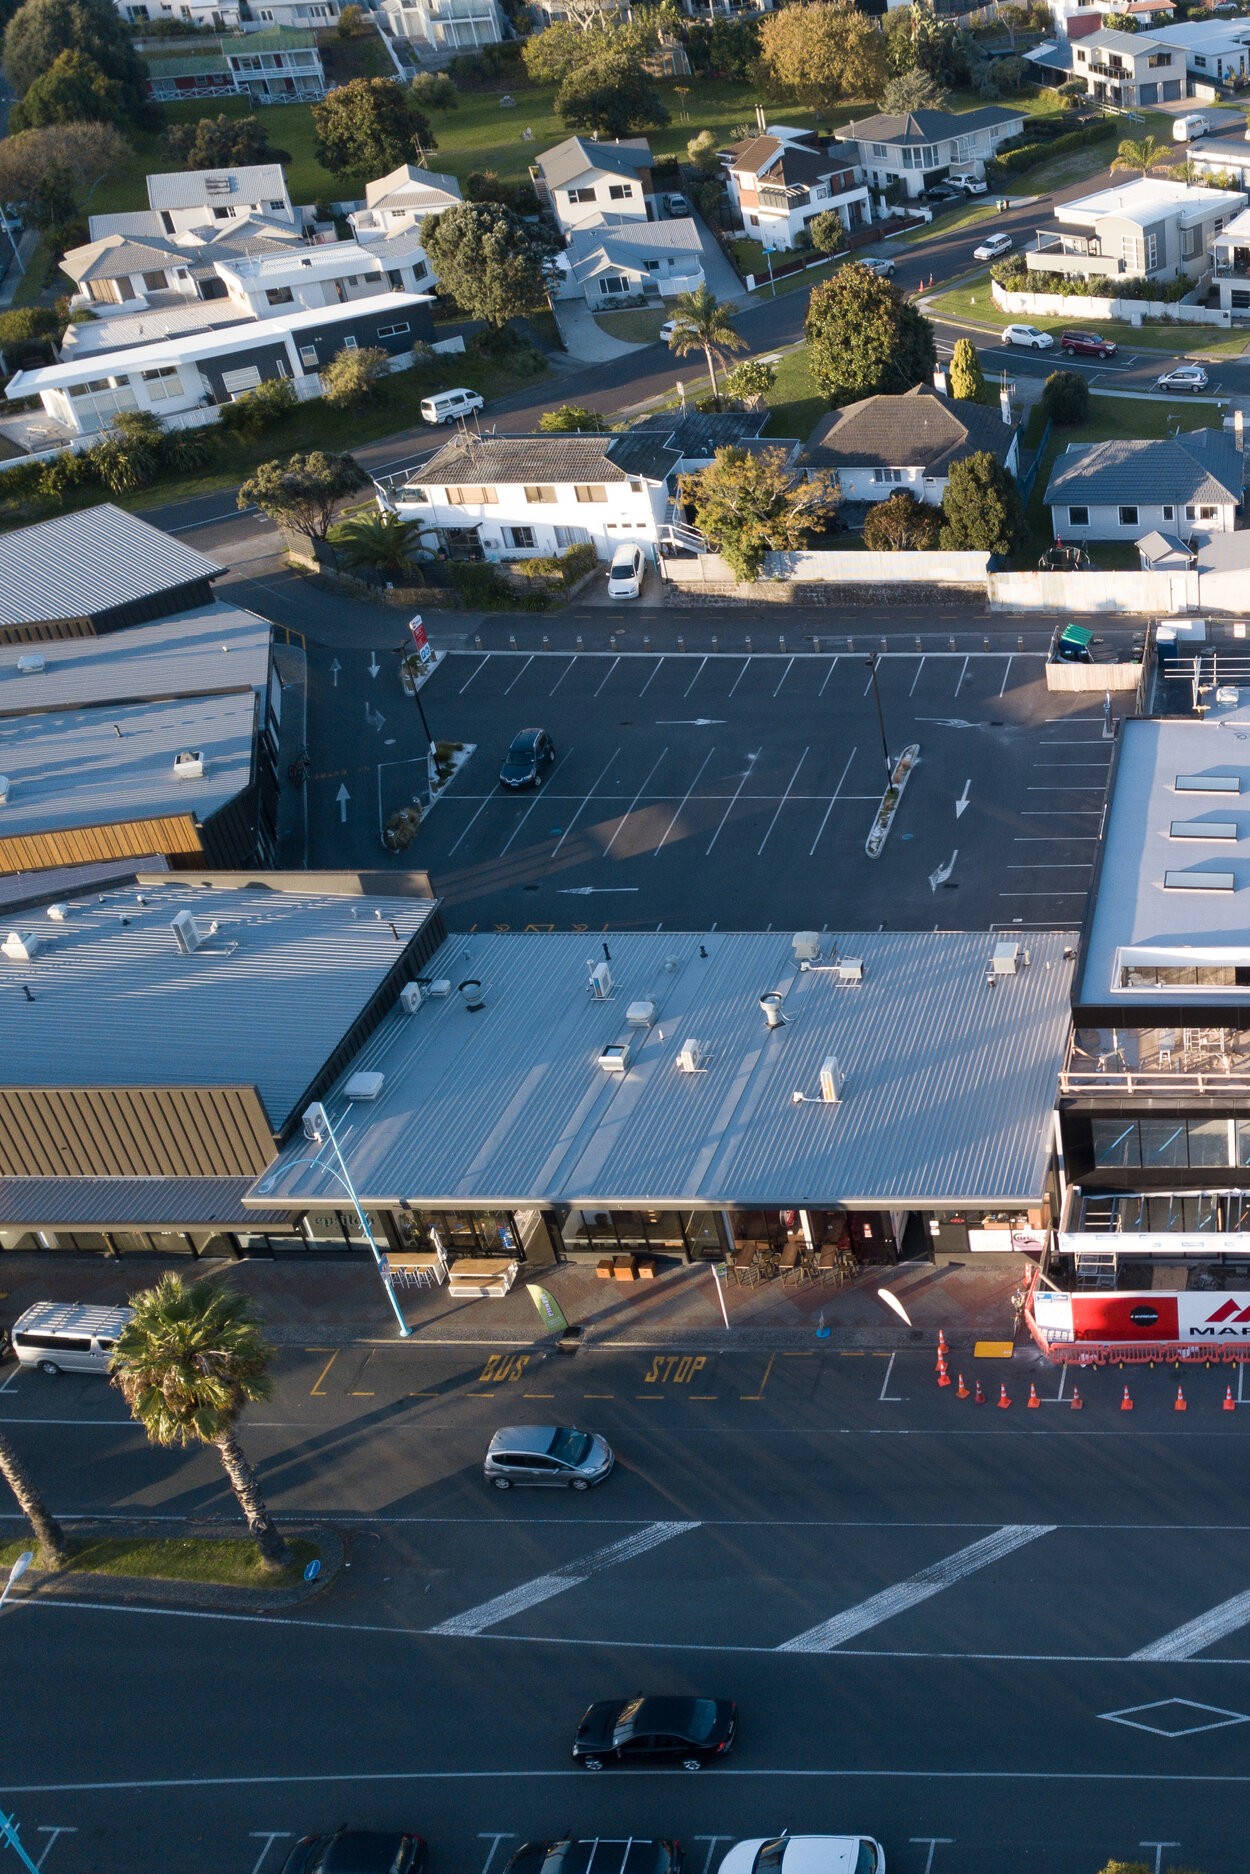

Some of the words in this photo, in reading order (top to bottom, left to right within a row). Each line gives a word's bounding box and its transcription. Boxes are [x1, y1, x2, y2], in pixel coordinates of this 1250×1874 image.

[315, 1214, 375, 1228] epilon
[480, 1354, 530, 1382] BUS
[644, 1356, 706, 1383] STOP
